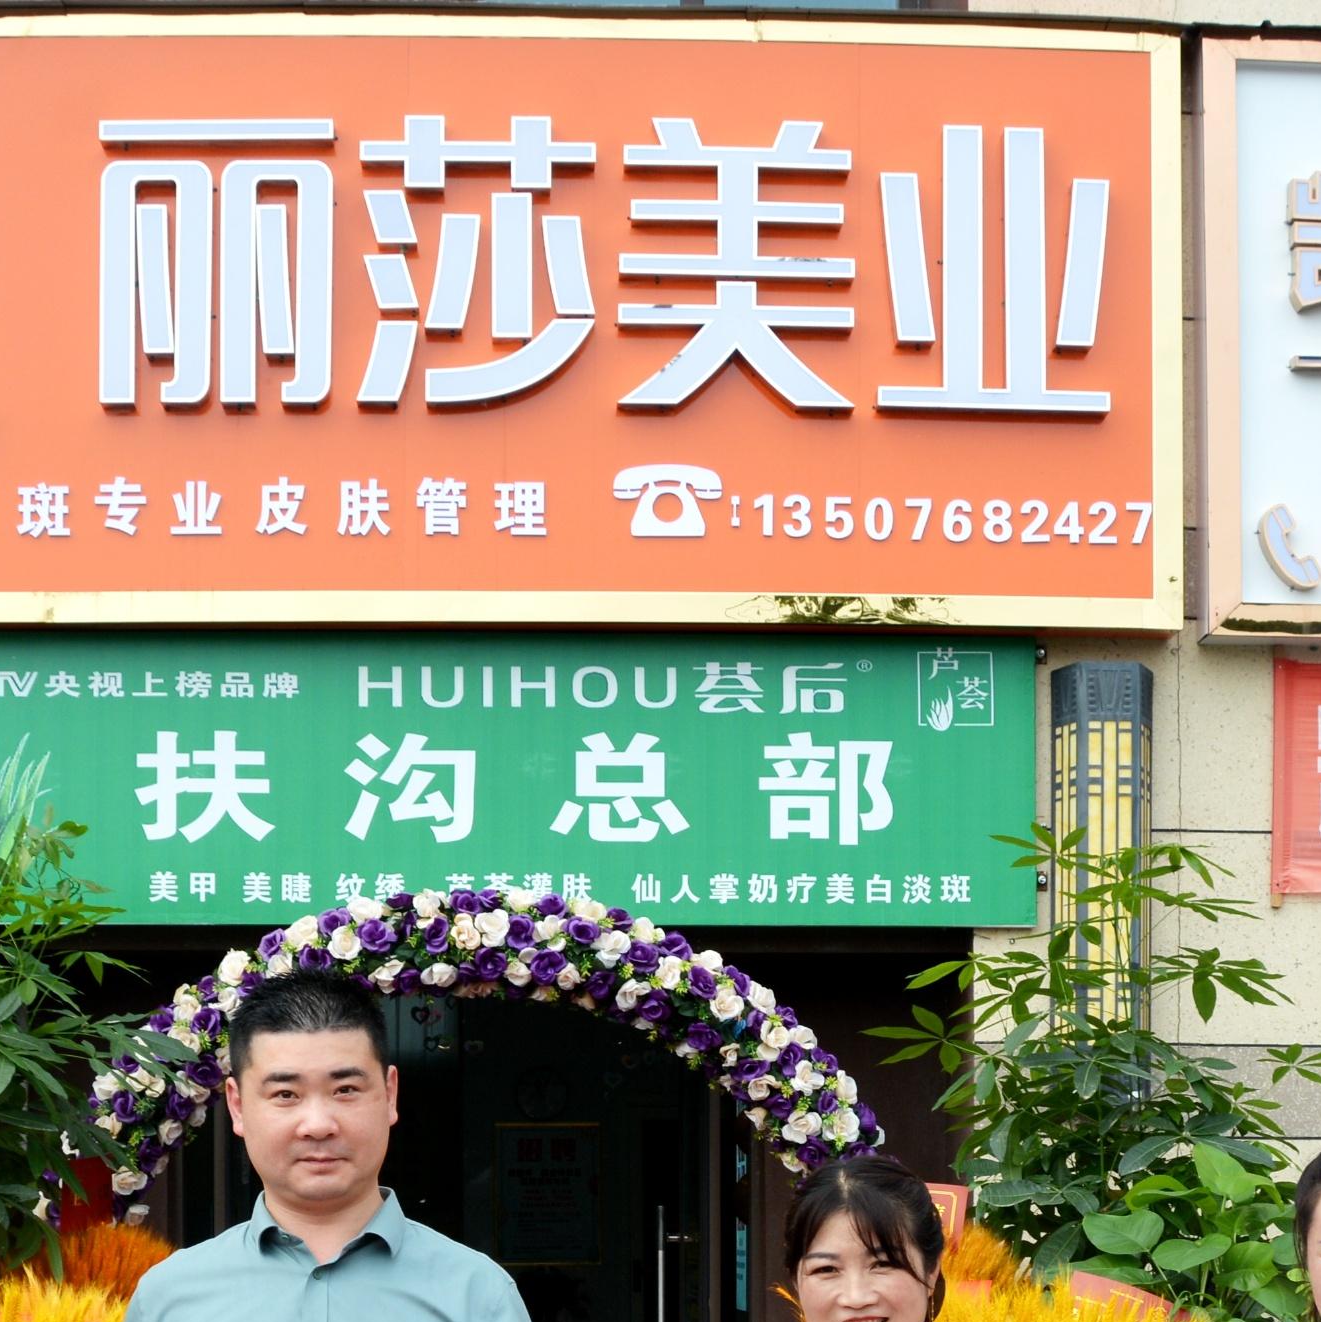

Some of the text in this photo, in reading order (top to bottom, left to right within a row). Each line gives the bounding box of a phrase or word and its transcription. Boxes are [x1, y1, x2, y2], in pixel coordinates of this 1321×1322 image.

[98, 115, 1111, 414] 丽莎美业
[134, 729, 895, 847] 扶沟总部
[149, 872, 217, 902] 美甲
[242, 872, 312, 903] 美睫
[631, 872, 972, 905] 仙人掌奶疗美白淡斑
